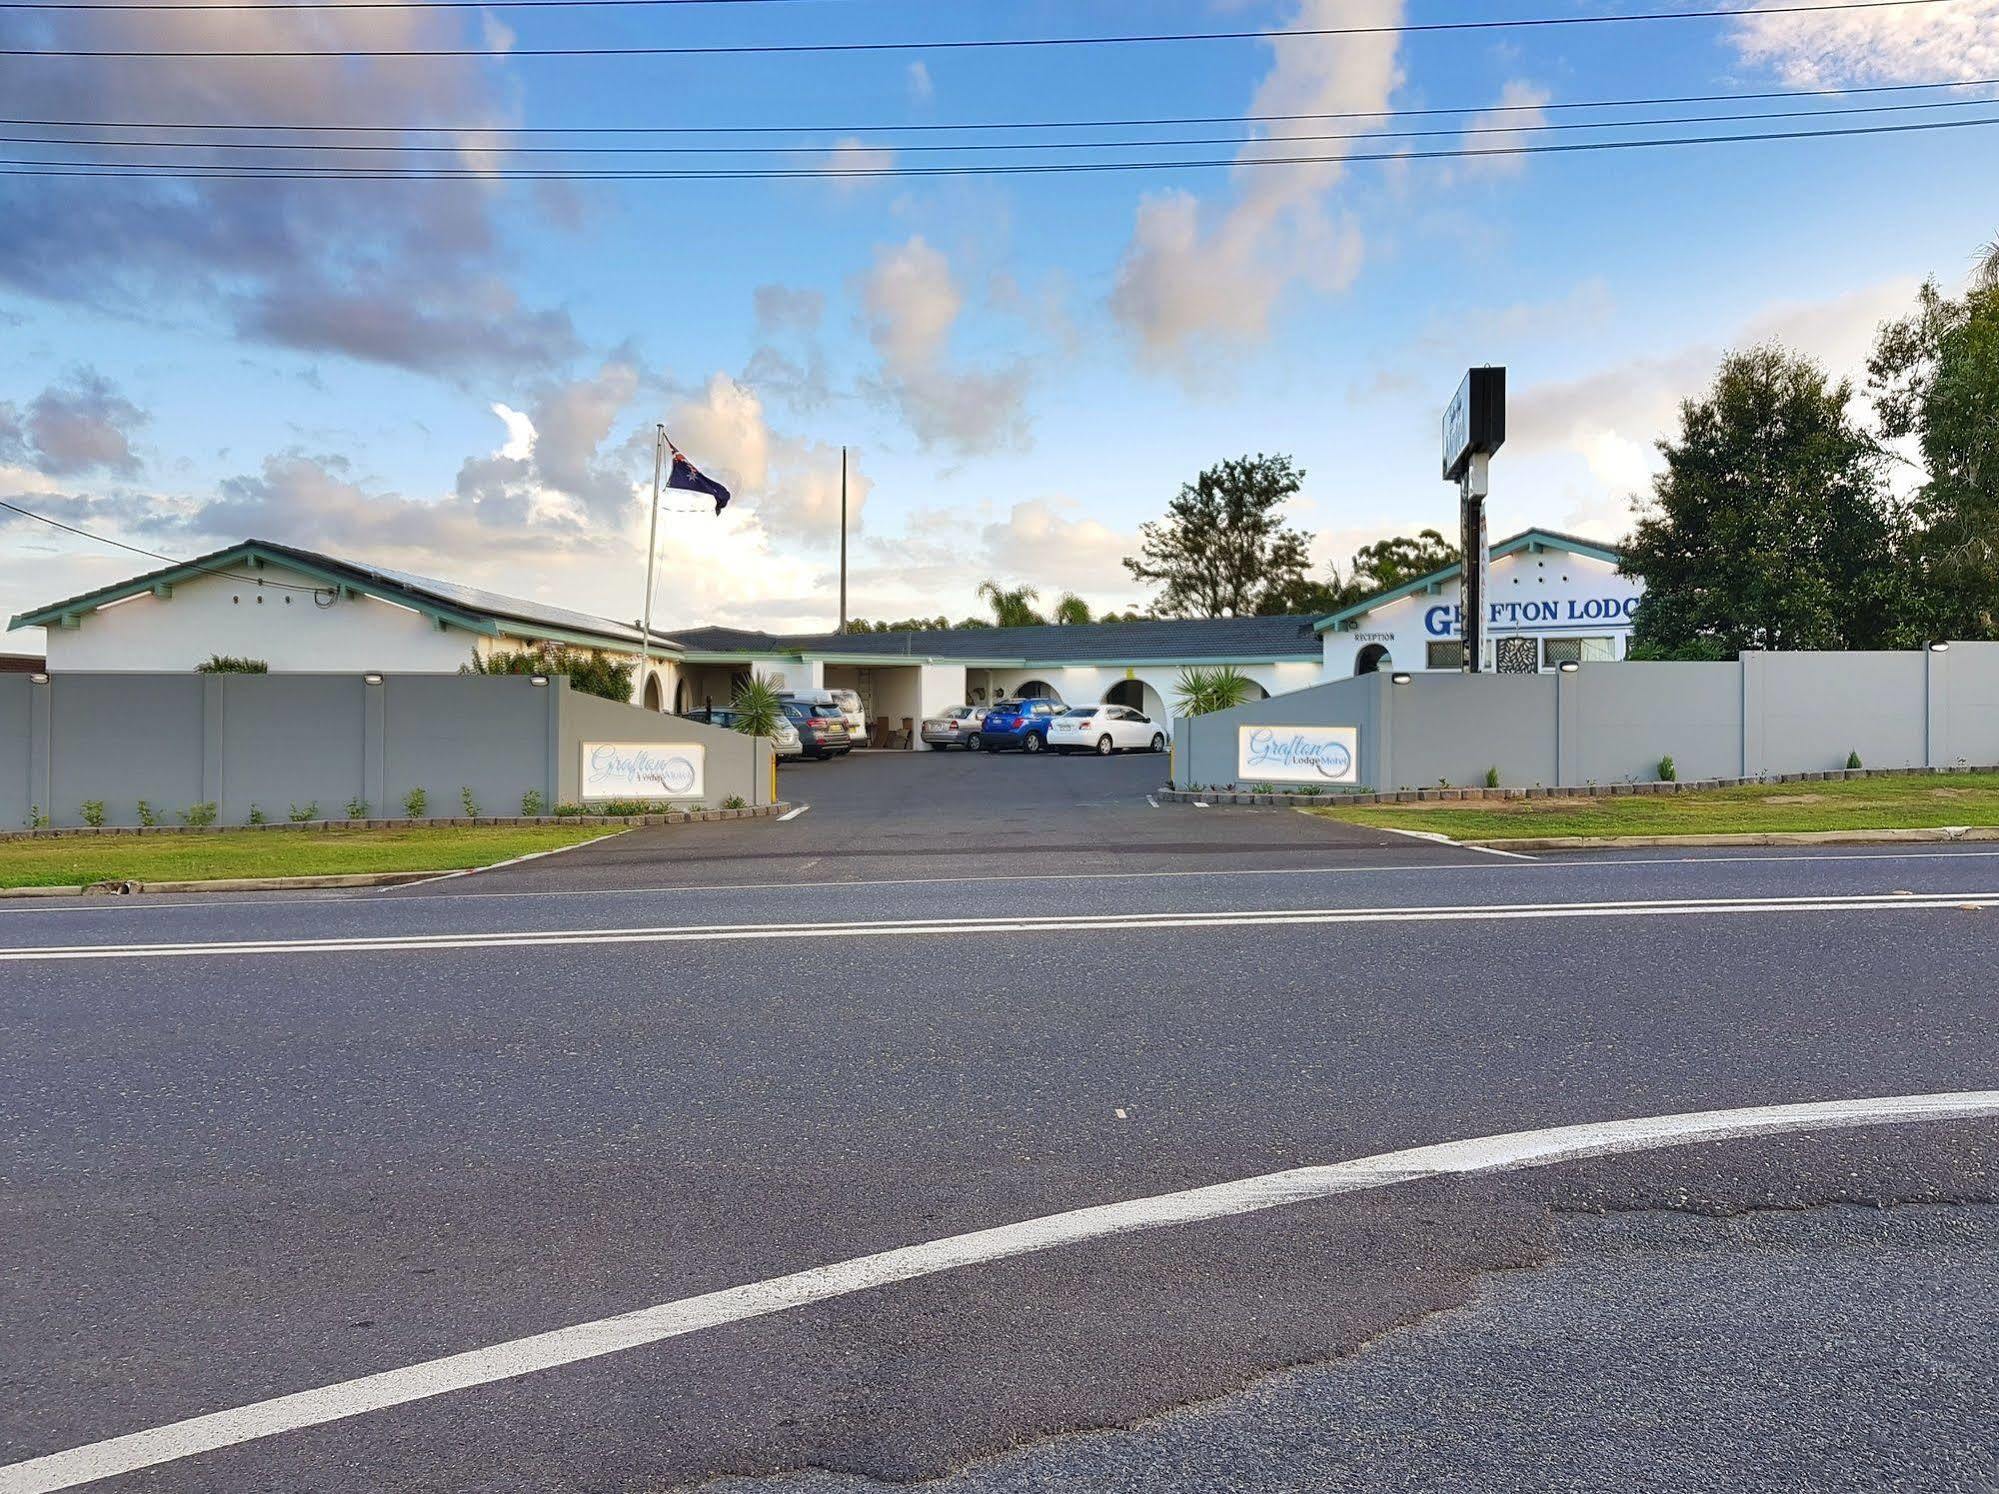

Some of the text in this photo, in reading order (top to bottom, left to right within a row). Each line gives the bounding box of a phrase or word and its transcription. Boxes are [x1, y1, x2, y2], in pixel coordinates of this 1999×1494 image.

[1424, 597, 1640, 636] GFTON LODG
[1353, 632, 1395, 641] RECEPTION
[589, 744, 668, 784] Grafton
[1248, 728, 1325, 769] Grafton
